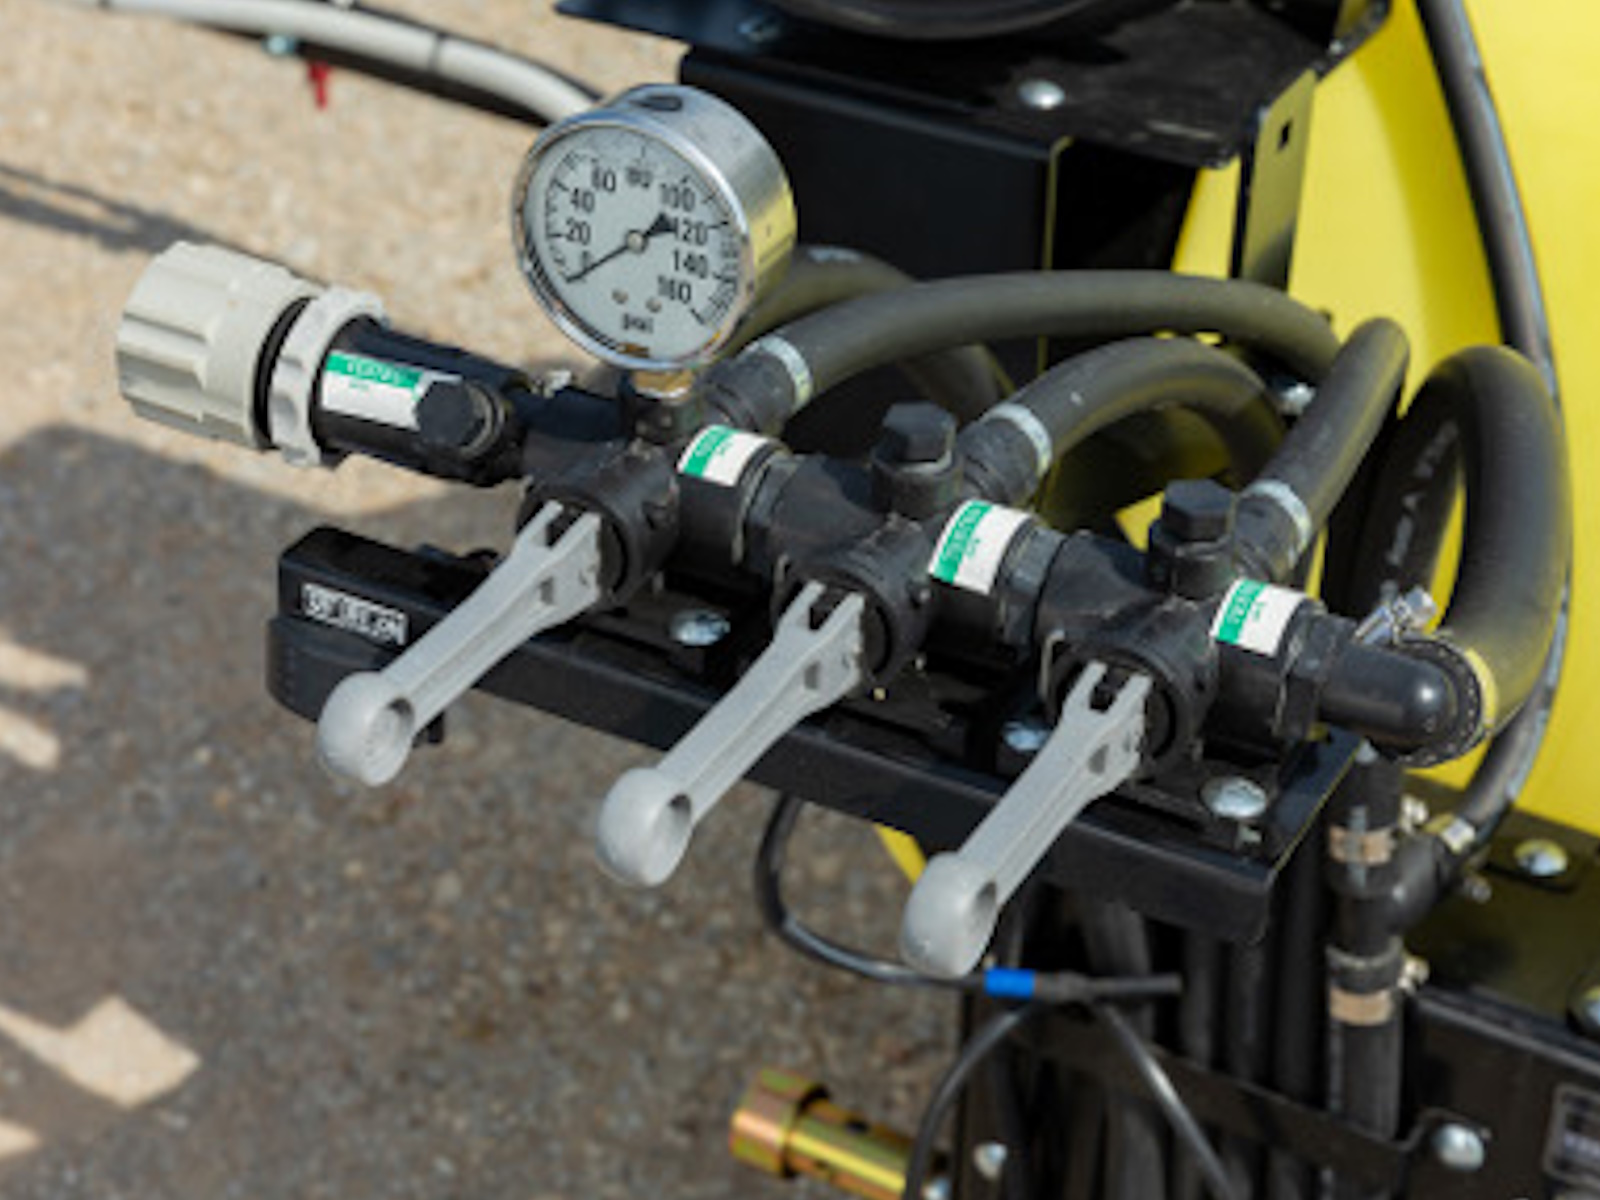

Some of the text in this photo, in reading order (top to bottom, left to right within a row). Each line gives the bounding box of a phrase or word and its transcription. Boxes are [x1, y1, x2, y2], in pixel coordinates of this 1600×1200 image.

[571, 188, 594, 211] 40
[662, 184, 695, 211] 100
[567, 218, 590, 244] 20
[674, 218, 707, 245] 120
[675, 250, 708, 278] 140
